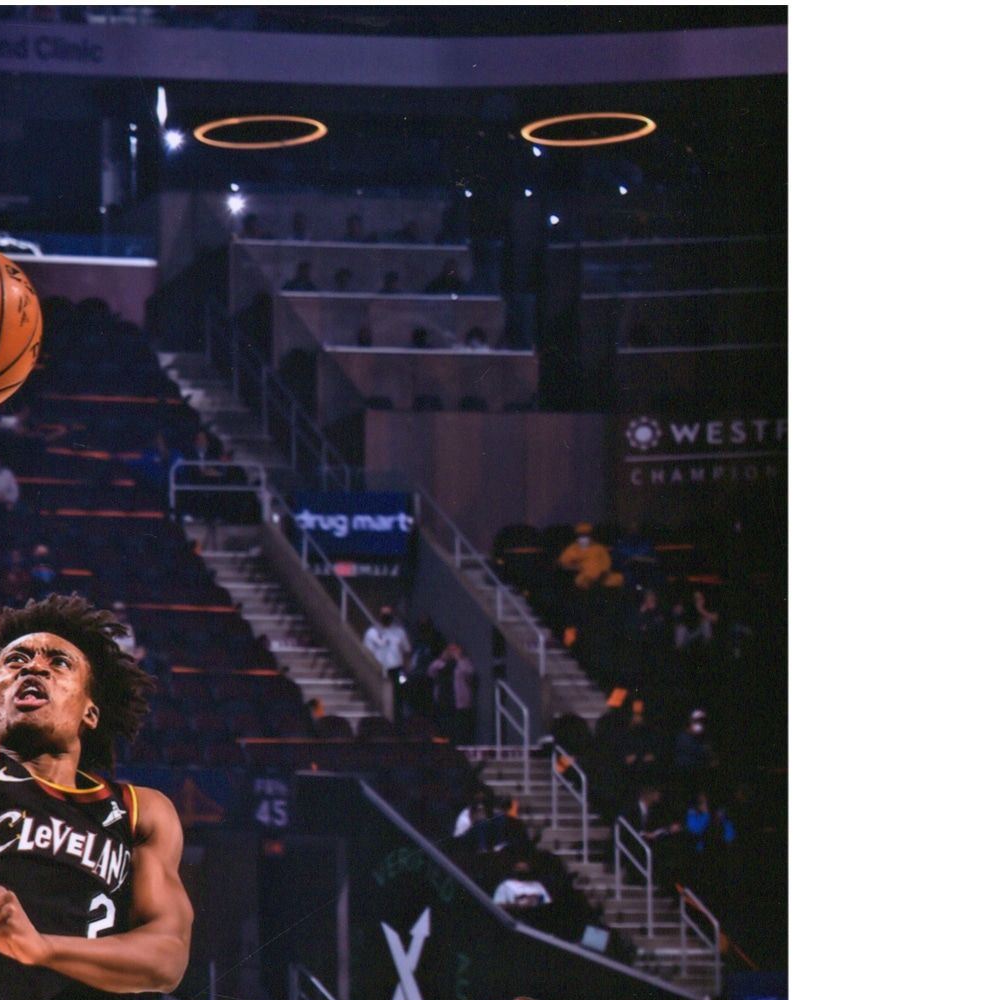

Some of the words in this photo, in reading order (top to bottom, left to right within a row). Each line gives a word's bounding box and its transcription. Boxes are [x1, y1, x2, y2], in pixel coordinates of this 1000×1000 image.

[294, 509, 349, 538] drug
[351, 511, 414, 532] mart
[254, 799, 289, 828] 45
[87, 893, 116, 939] 2
